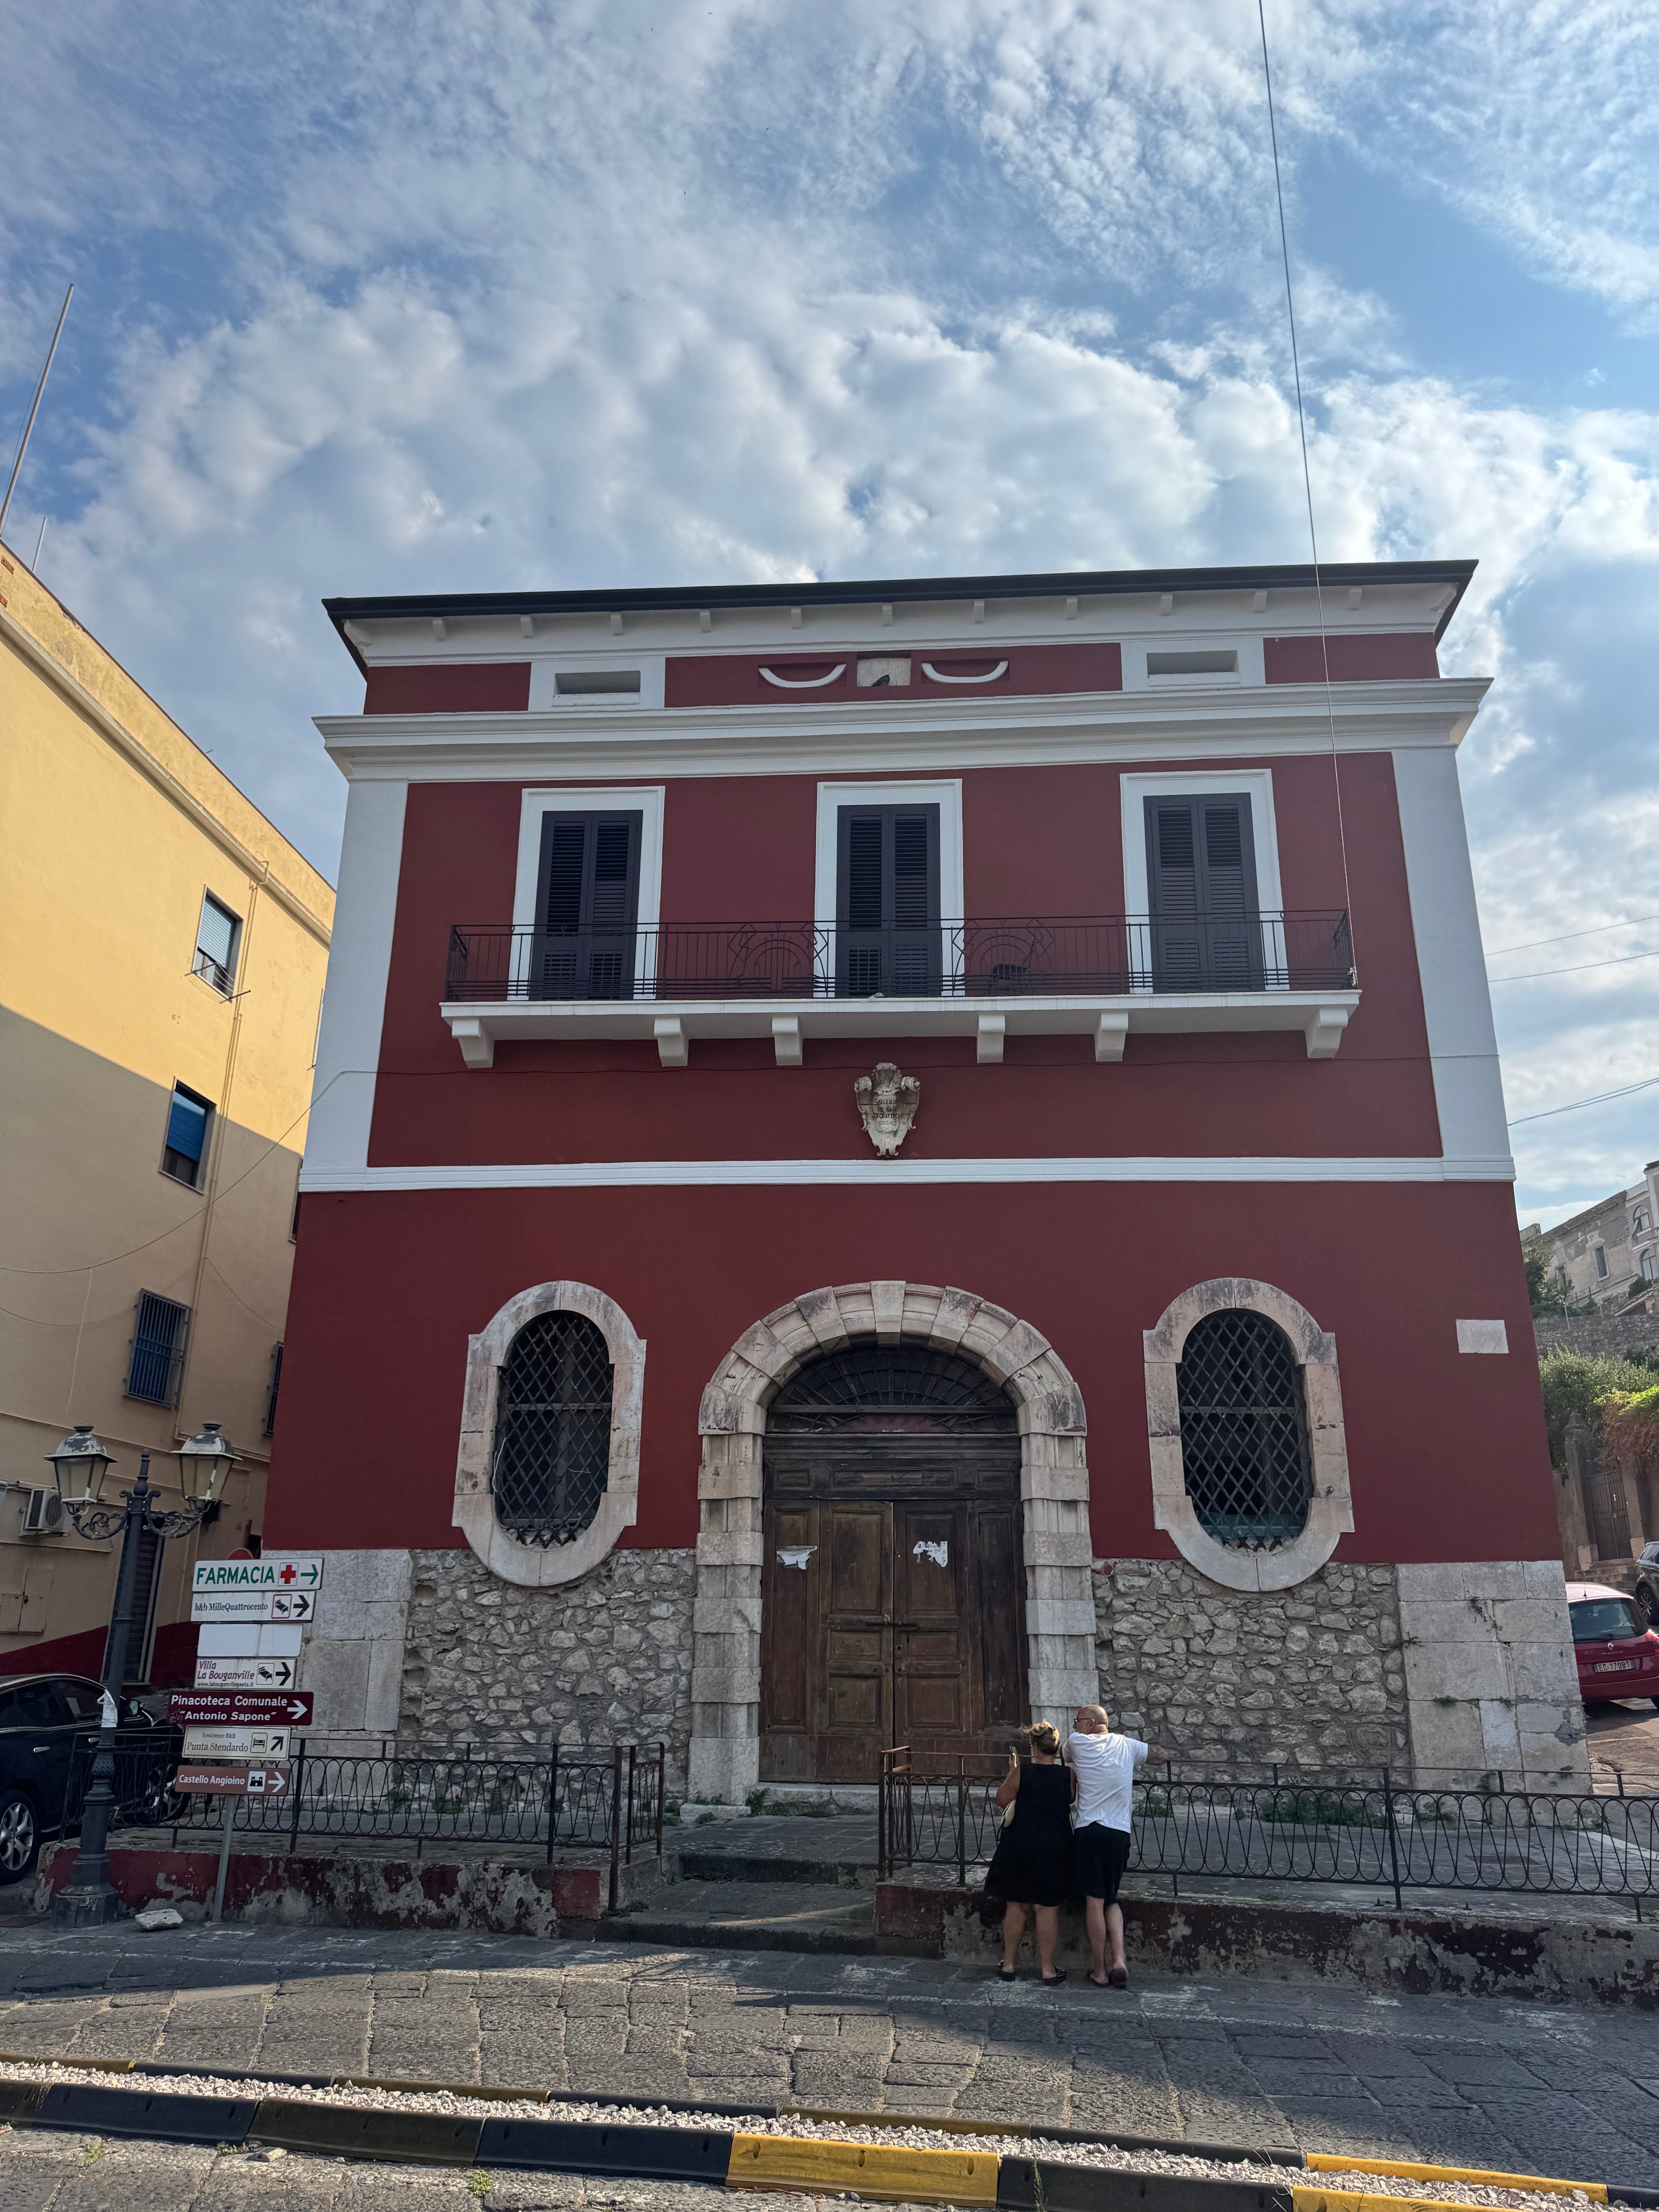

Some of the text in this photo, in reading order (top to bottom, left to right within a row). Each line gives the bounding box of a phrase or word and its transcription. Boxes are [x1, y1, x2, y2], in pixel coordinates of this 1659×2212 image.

[196, 1566, 275, 1585] FARMACIA
[195, 1602, 268, 1612] b&b MilleQuattrocento
[199, 1660, 216, 1669] Villa
[197, 1670, 255, 1681] La Bouganville
[171, 1695, 288, 1706] Pinacoteca Comunale
[180, 1711, 276, 1722] "Antonio Sapone"
[187, 1742, 248, 1751] Punta Stendardo
[179, 1774, 245, 1786] Castello Angioino
